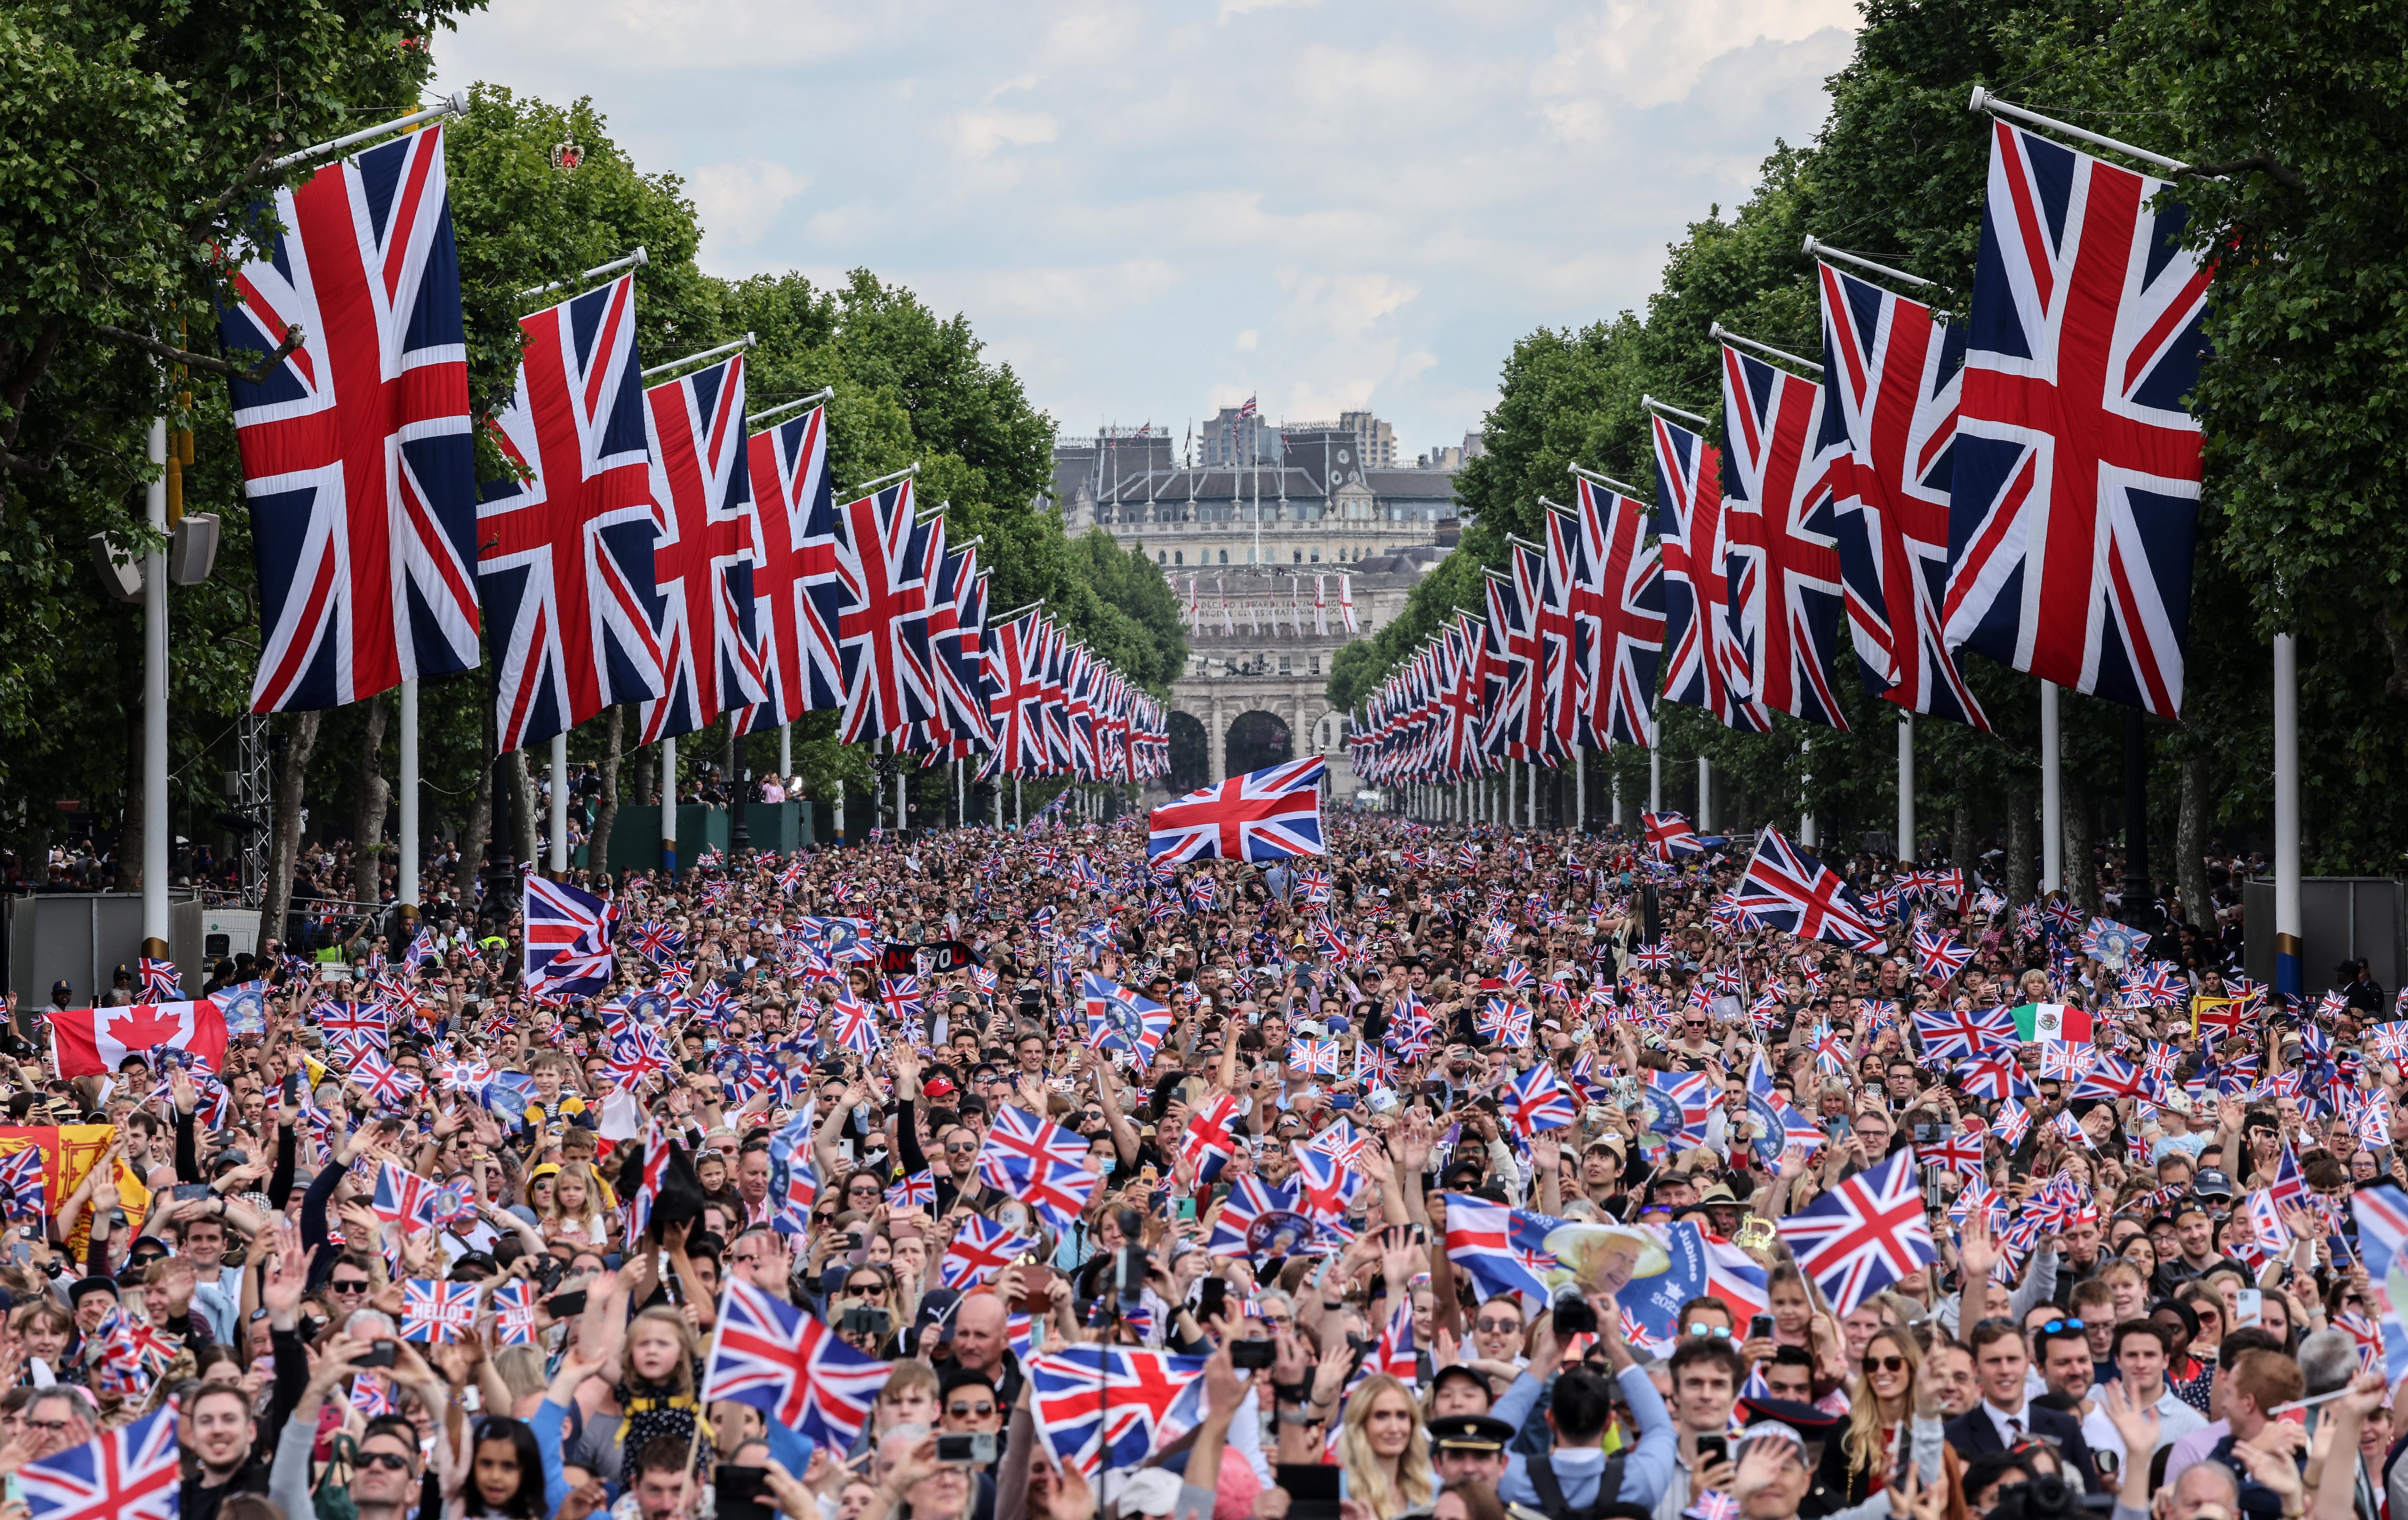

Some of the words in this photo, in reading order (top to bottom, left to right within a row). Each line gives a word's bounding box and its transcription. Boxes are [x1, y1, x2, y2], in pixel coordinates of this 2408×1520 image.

[2132, 974, 2141, 1003] HELLO!
[1488, 1012, 1523, 1033] HELLO!
[1863, 1007, 1888, 1020] HELLO!
[1296, 1049, 1329, 1063] HELLO!
[1364, 1054, 1393, 1074] HELLO!
[2051, 1053, 2090, 1069] HELLO!
[2146, 1053, 2177, 1070] HELLO!
[1678, 1229, 1698, 1282] Jubilee
[411, 1301, 465, 1325] HELLO!
